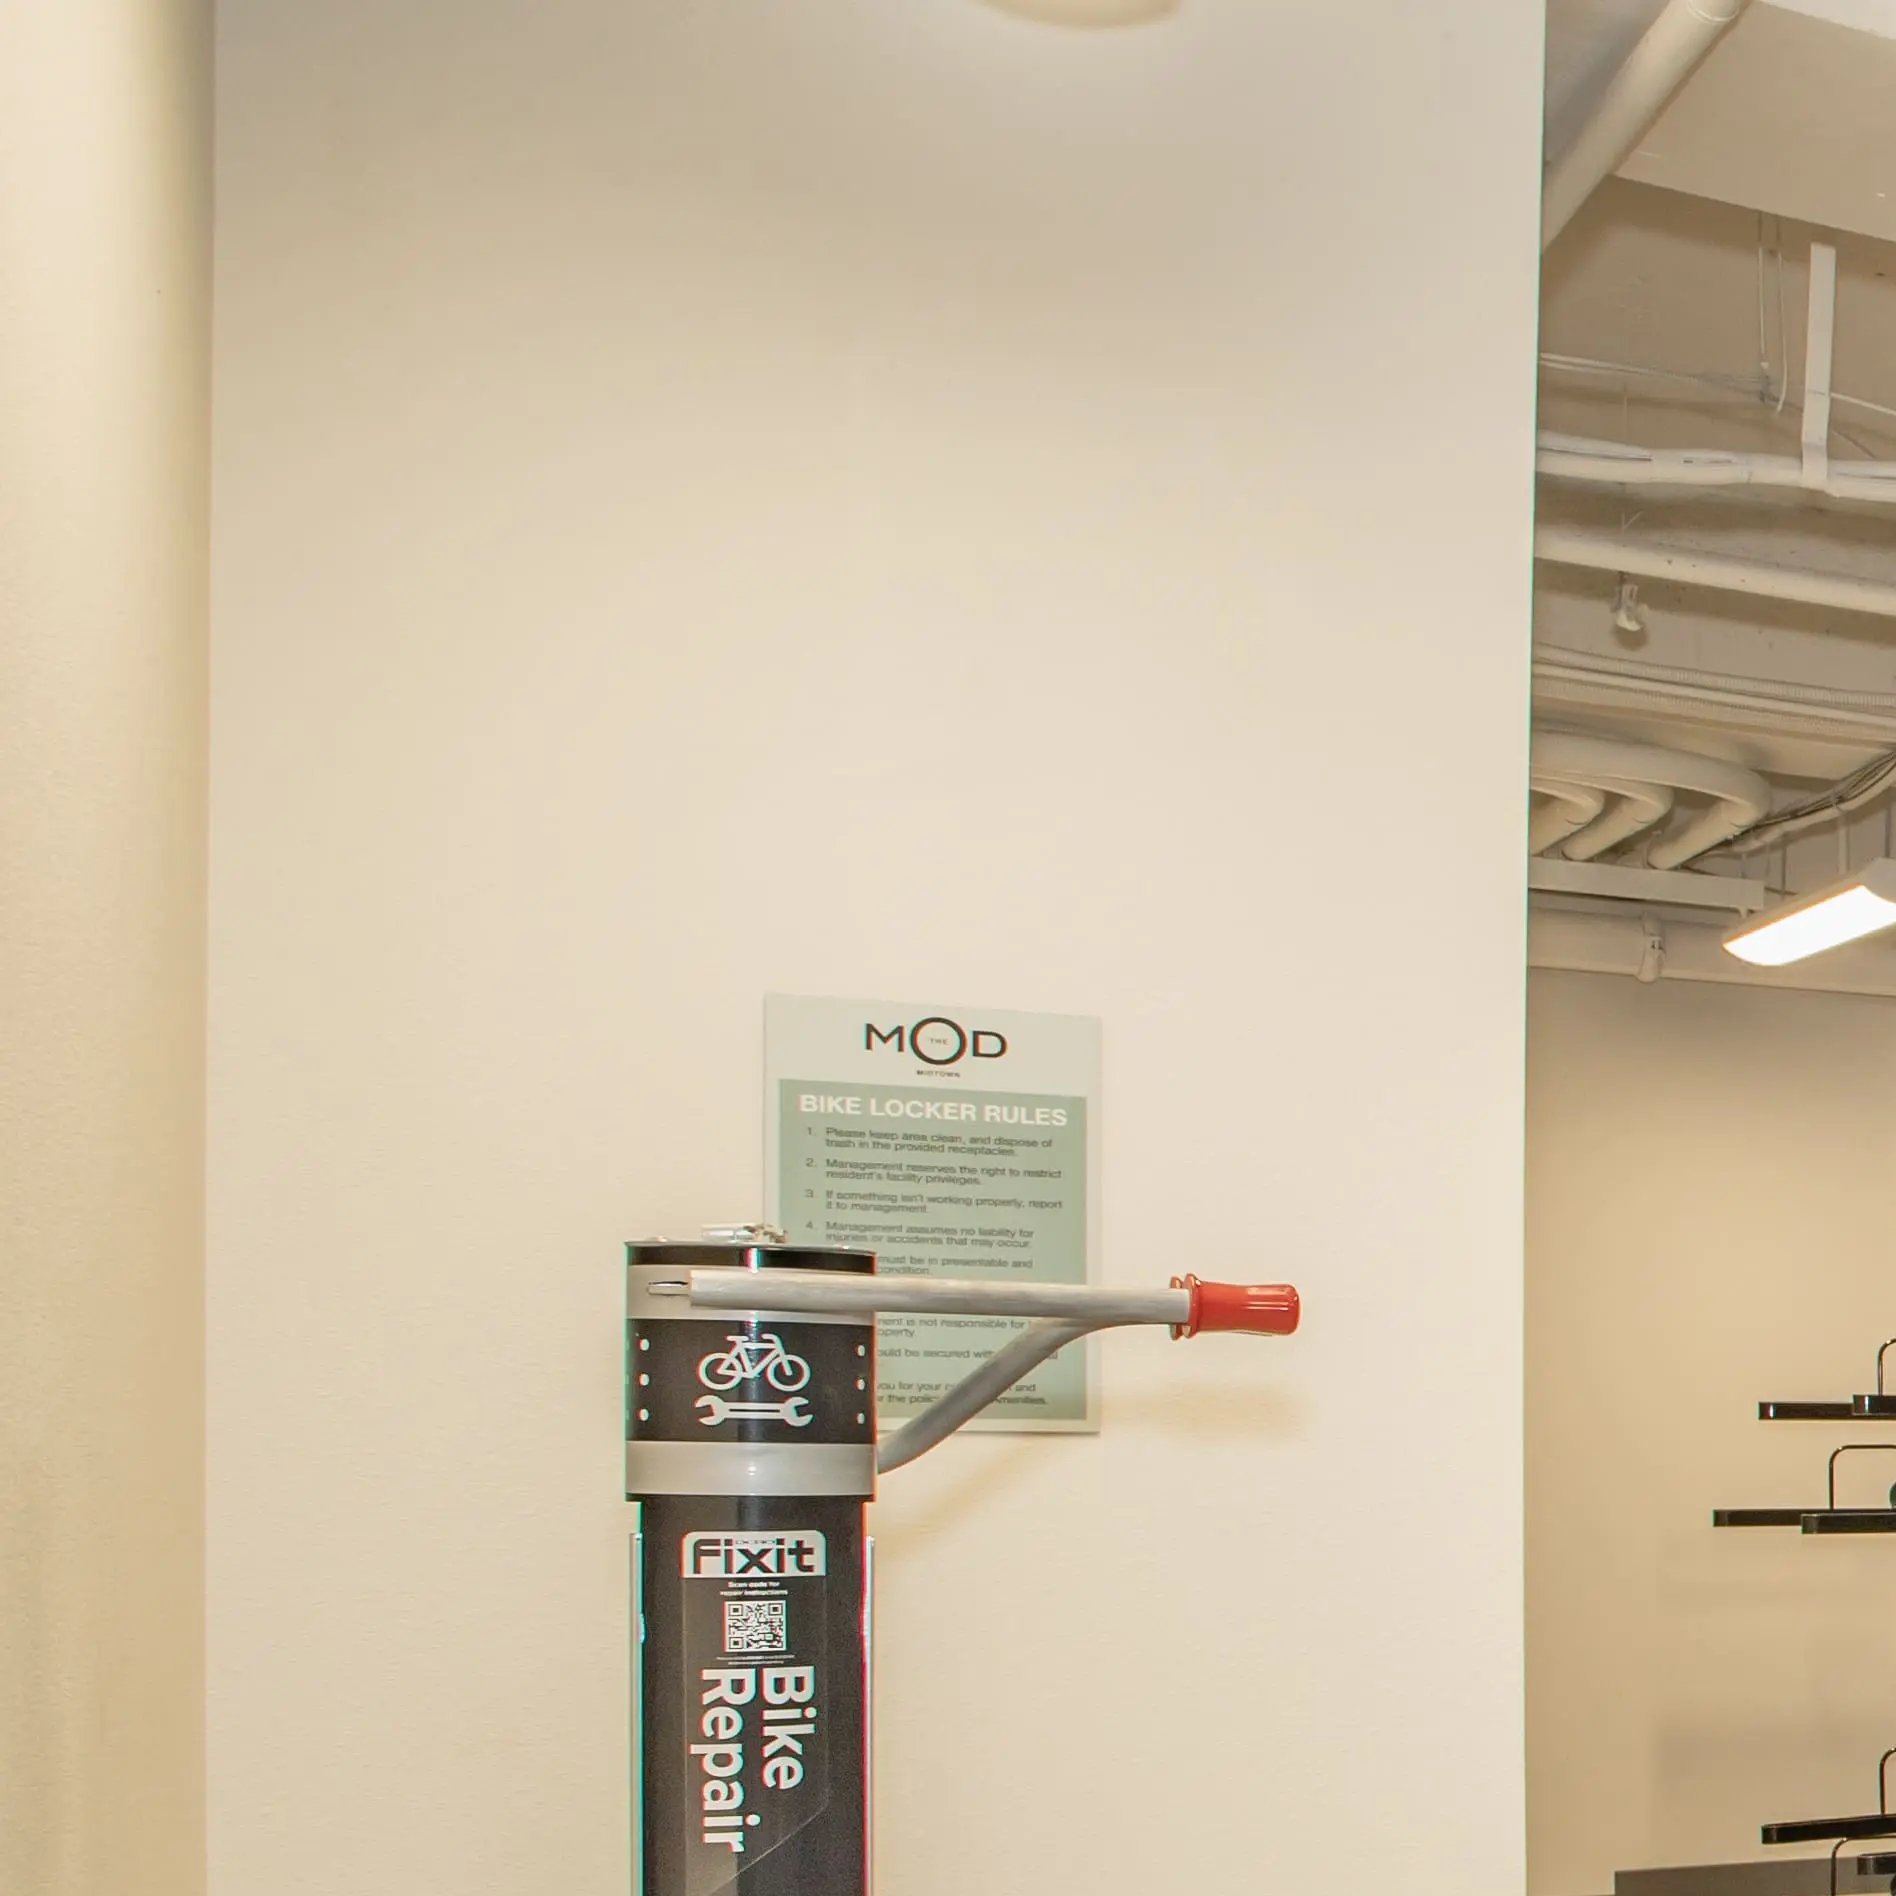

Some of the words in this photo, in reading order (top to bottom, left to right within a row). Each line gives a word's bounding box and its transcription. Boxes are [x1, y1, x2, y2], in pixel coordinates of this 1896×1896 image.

[864, 1016, 1008, 1065] MOD
[916, 1070, 960, 1078] MIDTOWN
[799, 1094, 862, 1115] BIKE
[869, 1097, 977, 1121] LOCKER
[985, 1102, 1068, 1126] RULES
[825, 1126, 866, 1138] Please
[869, 1130, 899, 1141] keep
[902, 1133, 928, 1141] area
[931, 1133, 966, 1145] clean,
[970, 1136, 991, 1145] and
[994, 1136, 1039, 1148] dispose
[1041, 1139, 1053, 1148] of
[825, 1139, 855, 1148] trash
[858, 1140, 869, 1149] in
[872, 1141, 891, 1149] the
[894, 1143, 944, 1152] provided
[948, 1145, 1018, 1156] receptacles.
[805, 1157, 817, 1168] 2.
[826, 1158, 903, 1171] Management
[906, 1164, 957, 1173] reserves
[959, 1166, 978, 1175] the
[981, 1167, 1006, 1178] right
[1009, 1168, 1021, 1177] to
[1023, 1169, 1062, 1179] restrict
[826, 1170, 883, 1181] resident's
[886, 1172, 923, 1184] facility
[925, 1174, 983, 1186] privileges.
[826, 1190, 834, 1200] If
[836, 1192, 898, 1204] something
[901, 1194, 924, 1203] isn't
[926, 1195, 973, 1207] working
[975, 1197, 1026, 1209] properly,
[1028, 1200, 1063, 1210] report
[826, 1201, 832, 1210] it
[836, 1202, 847, 1210] to
[805, 1220, 818, 1230] 4.
[826, 1221, 903, 1233] Management
[905, 1226, 957, 1236] assumes
[960, 1228, 975, 1236] no
[978, 1227, 1016, 1240] liability
[1018, 1228, 1035, 1238] for
[826, 1232, 868, 1243] injuries
[871, 1234, 883, 1242] or
[886, 1235, 943, 1246] accidents
[946, 1236, 968, 1246] that
[970, 1238, 993, 1248] may
[997, 1239, 1032, 1249] occur.
[878, 1255, 907, 1264] must
[909, 1256, 925, 1265] be
[928, 1256, 938, 1266] in
[941, 1258, 1009, 1268] presentable
[1011, 1259, 1033, 1269] and
[906, 1318, 916, 1327] is
[919, 1318, 938, 1327] not
[940, 1319, 1008, 1330] responsible
[1010, 1319, 1025, 1329] for
[904, 1349, 920, 1358] be
[922, 1350, 970, 1359] secured
[898, 1381, 914, 1391] for
[916, 1383, 942, 1393] your
[1015, 1383, 1037, 1393] and
[888, 1394, 906, 1404] the
[693, 1538, 815, 1574] Fixit
[761, 1665, 817, 1790] Bike
[690, 1668, 761, 1853] Repair
